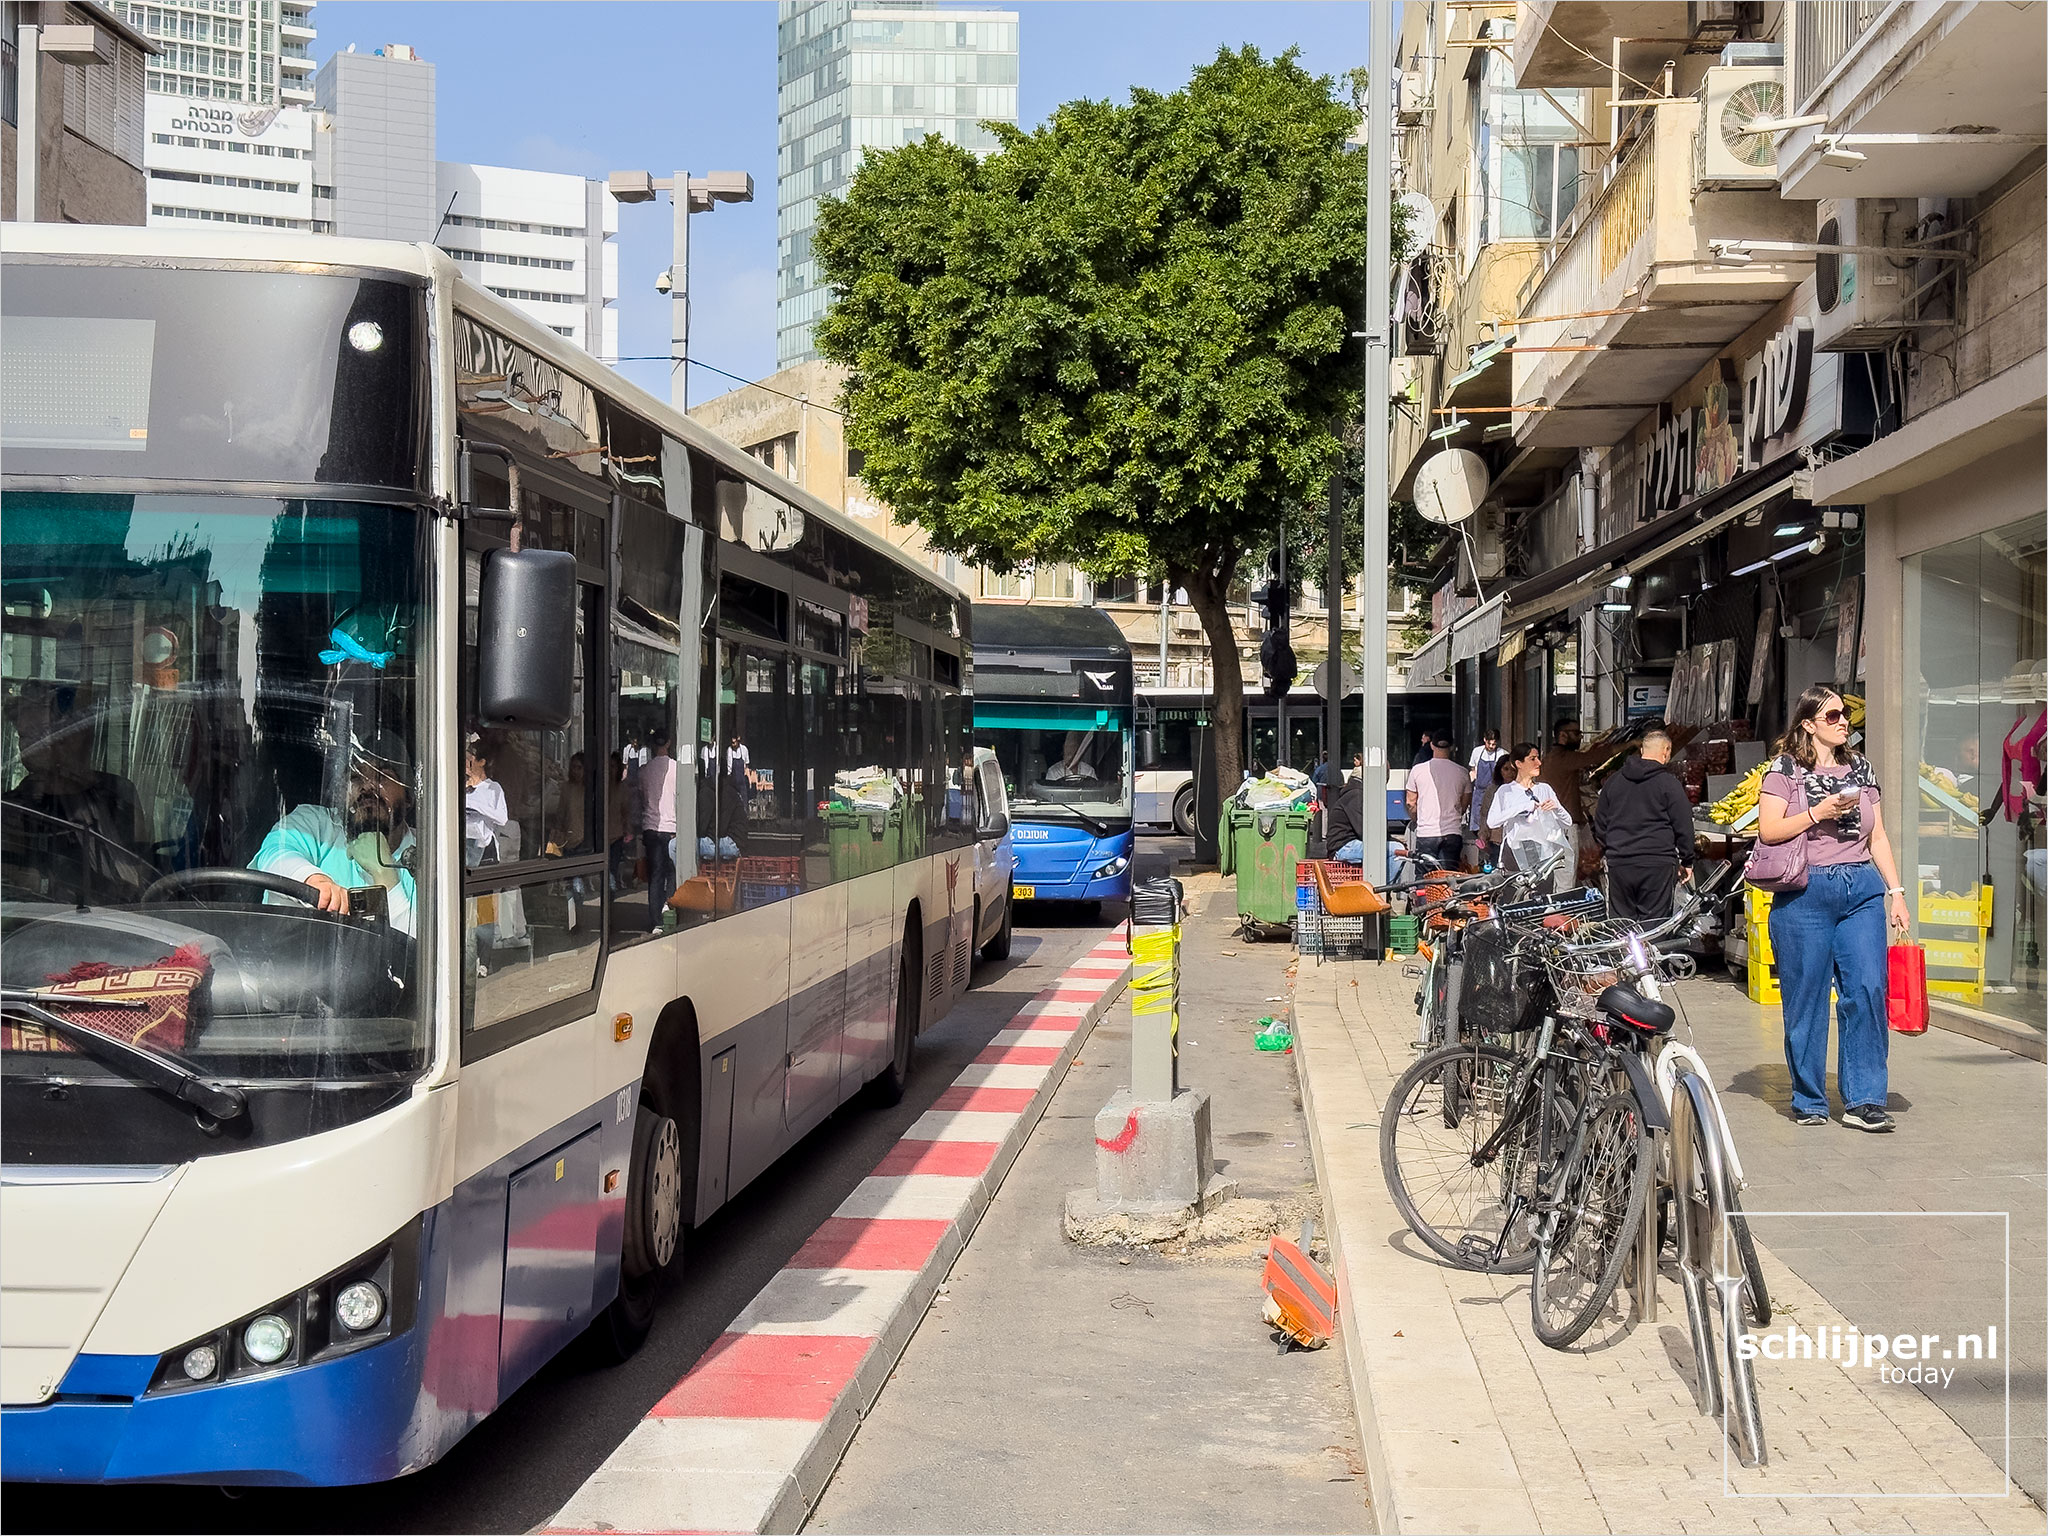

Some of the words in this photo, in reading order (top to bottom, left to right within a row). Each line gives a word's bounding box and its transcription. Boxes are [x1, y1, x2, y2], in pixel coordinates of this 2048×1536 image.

[188, 106, 233, 121] מנורה
[171, 118, 233, 135] מבטחים
[1636, 402, 1695, 522] העליה
[1017, 829, 1049, 840] אוטובוס
